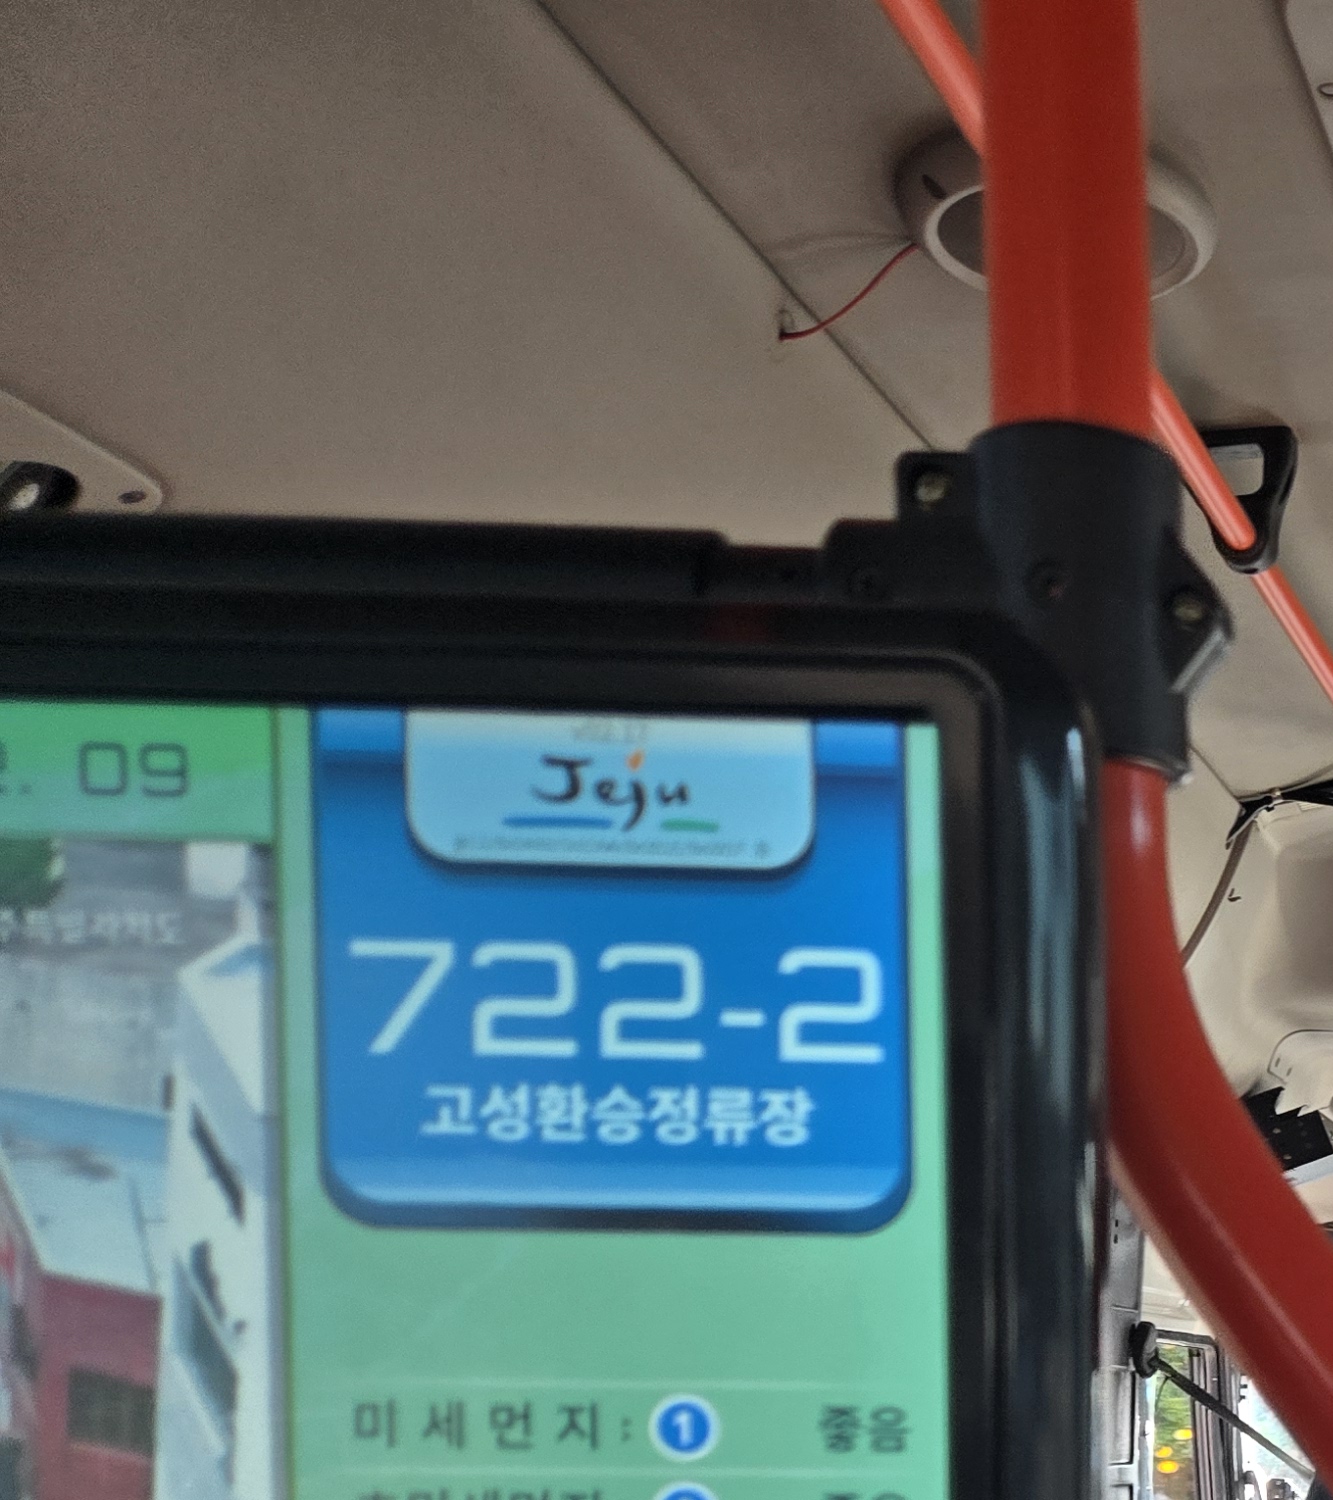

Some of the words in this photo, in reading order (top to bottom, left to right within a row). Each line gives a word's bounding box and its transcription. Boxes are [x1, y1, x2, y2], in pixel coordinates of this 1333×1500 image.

[77, 740, 190, 798] 09
[530, 748, 692, 834] Jeju
[347, 938, 886, 1065] 722-2
[421, 1083, 816, 1147] 고성환승정류장
[819, 1403, 913, 1455] 좋음
